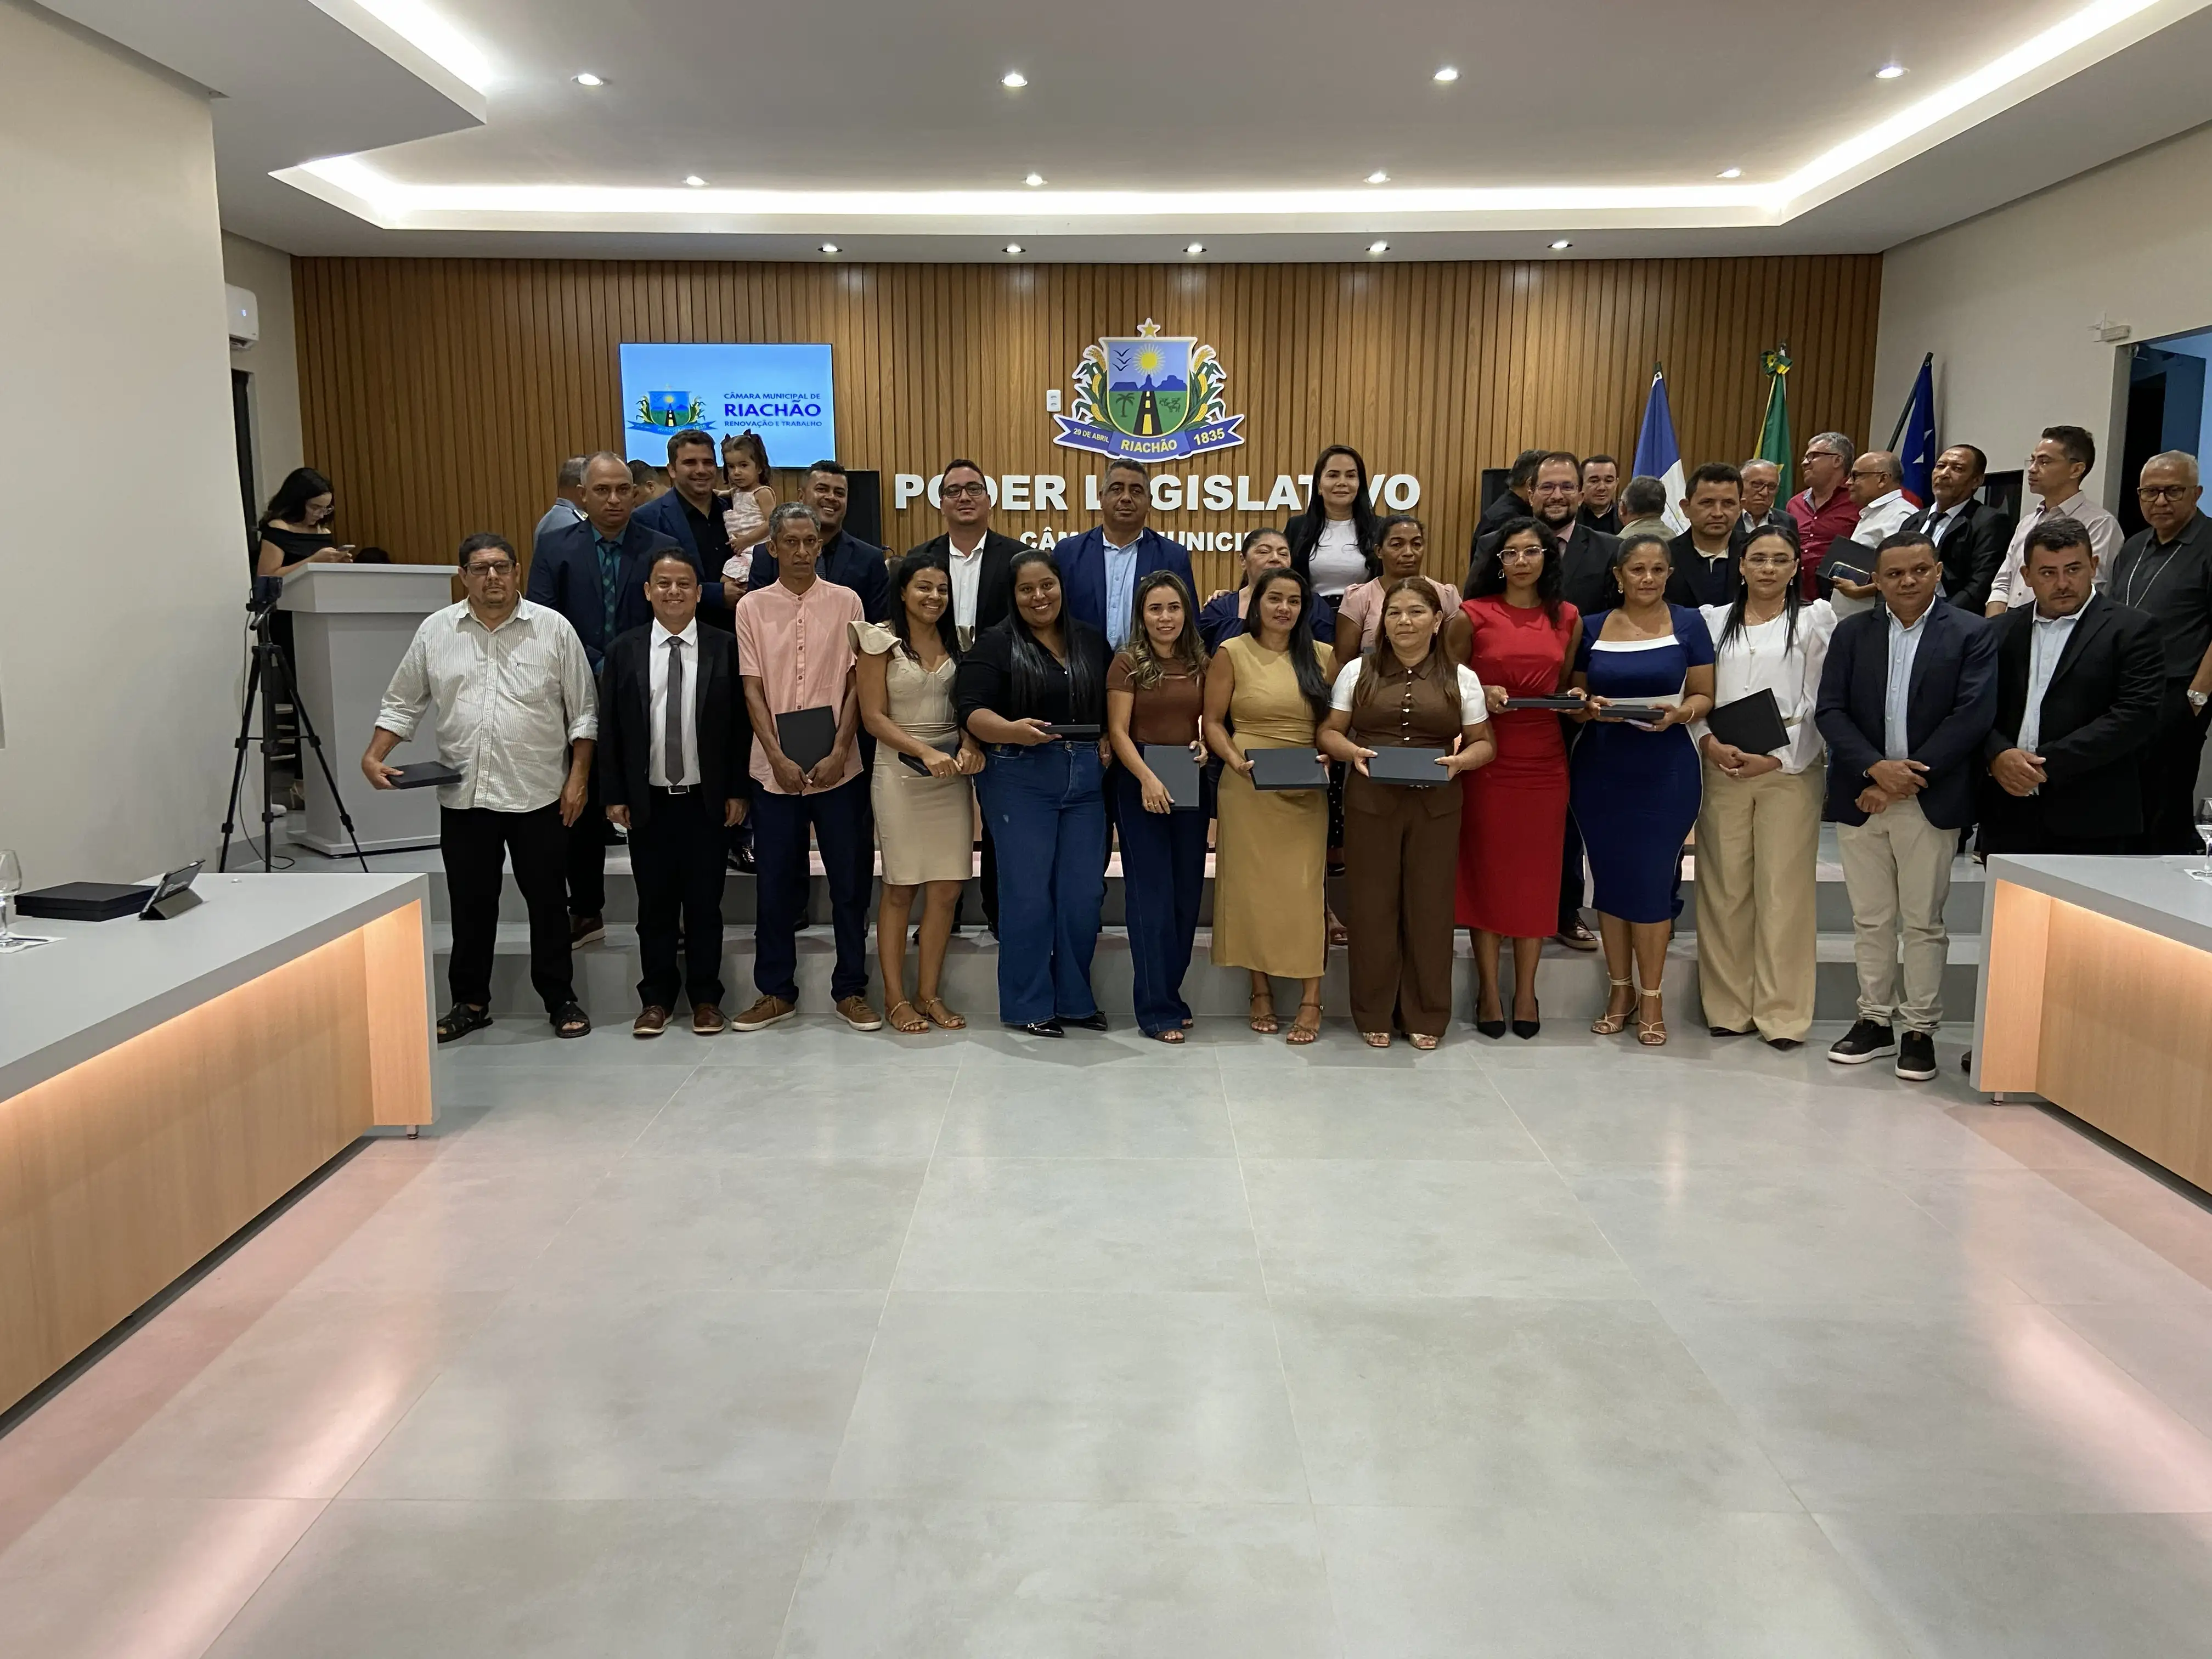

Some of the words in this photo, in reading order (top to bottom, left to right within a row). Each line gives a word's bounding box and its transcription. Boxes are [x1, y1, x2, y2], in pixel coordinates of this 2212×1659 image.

[724, 399, 821, 417] RIACHÃO
[724, 420, 774, 428] RENOVAÇÃO
[1082, 430, 1092, 438] DE
[1092, 433, 1109, 443] ABRIL
[1193, 427, 1226, 445] 1835
[1121, 438, 1177, 453] RIACHÃO
[1085, 473, 1421, 511] LGISLAO
